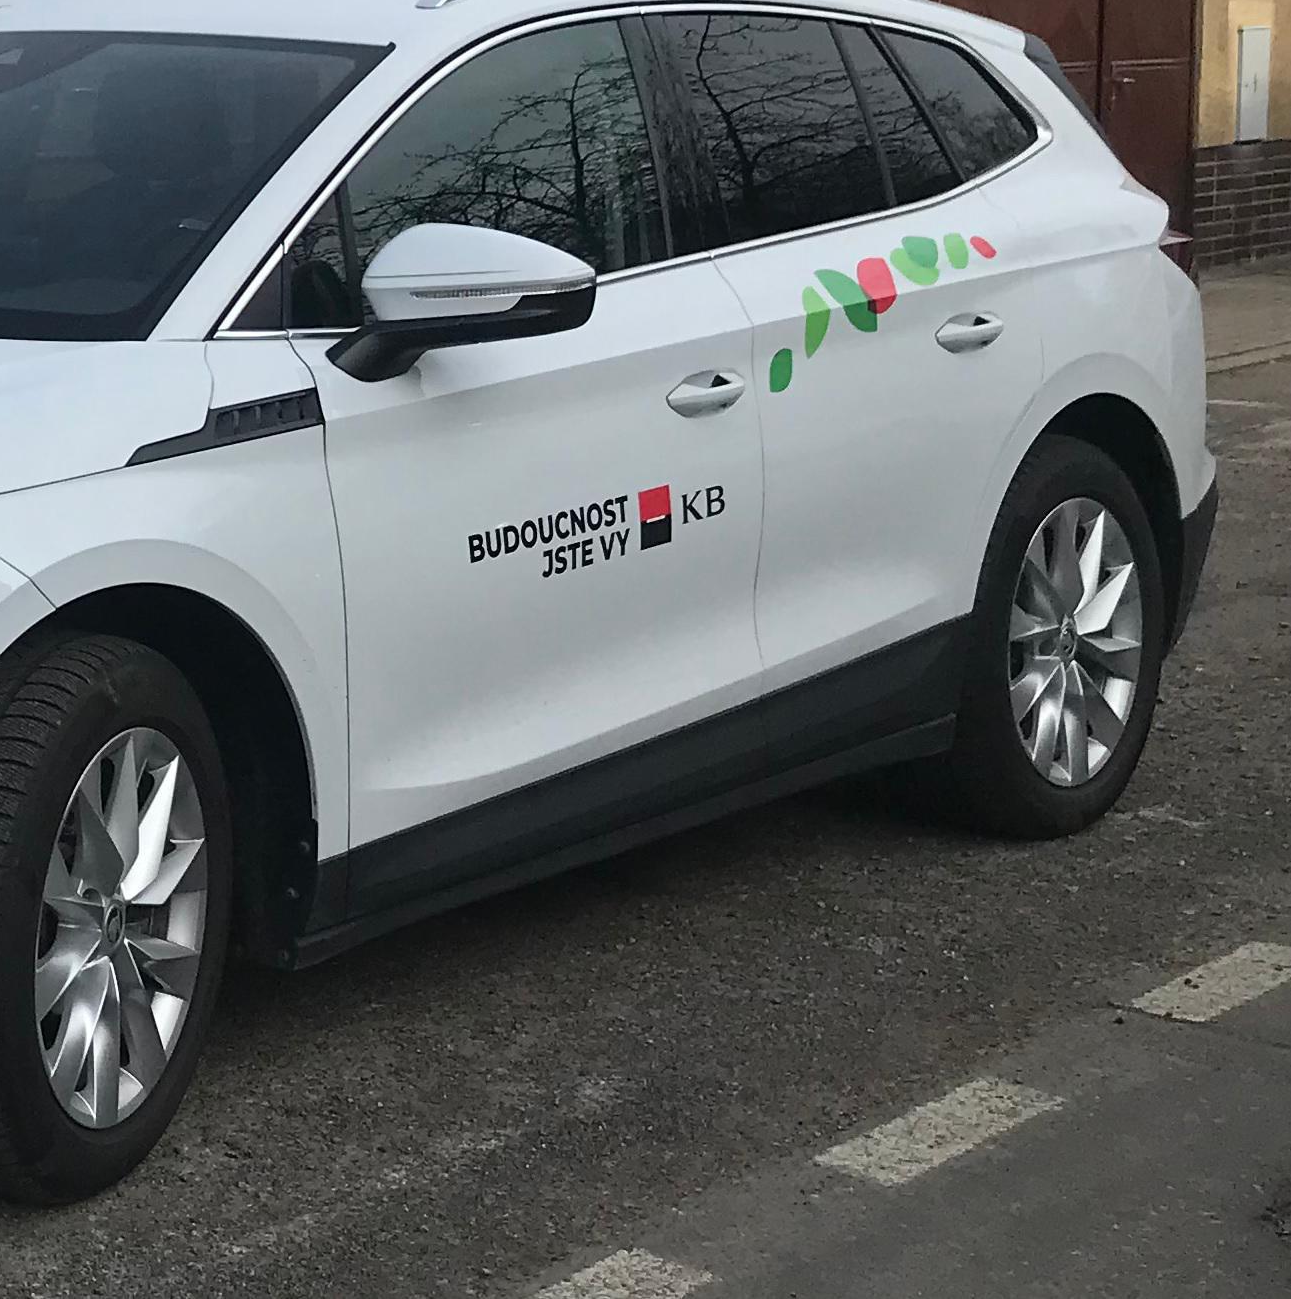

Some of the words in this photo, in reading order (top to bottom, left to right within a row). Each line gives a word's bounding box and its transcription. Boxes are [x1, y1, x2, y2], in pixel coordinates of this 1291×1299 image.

[468, 495, 629, 564] BUDOUCNOST
[681, 485, 726, 524] KB
[541, 538, 594, 578] JSTE
[599, 528, 631, 561] VY
